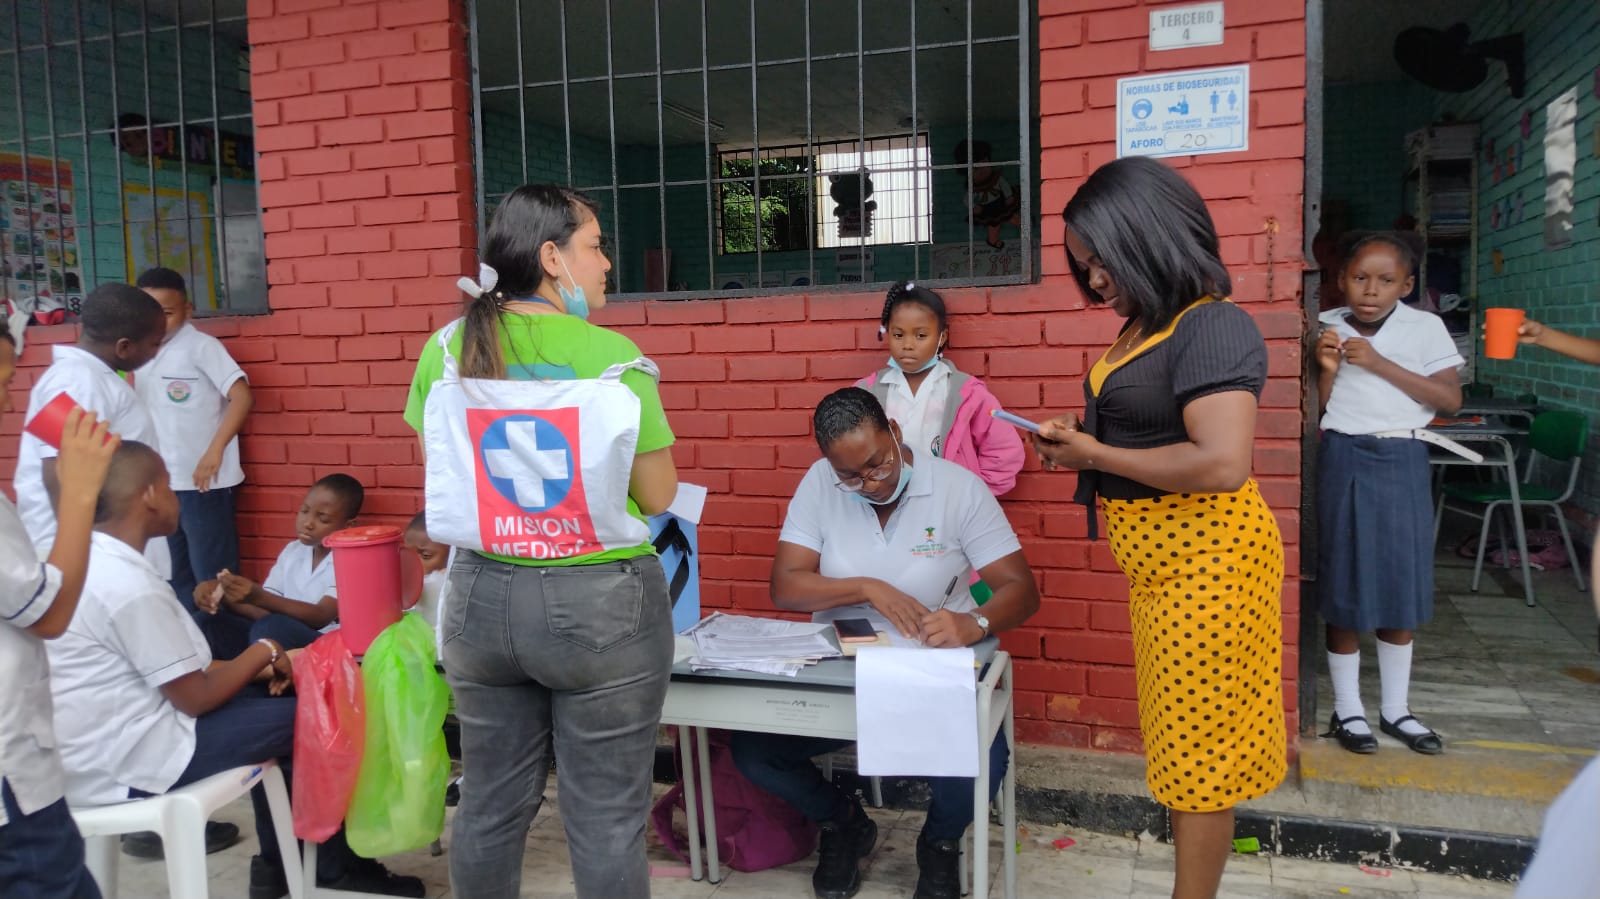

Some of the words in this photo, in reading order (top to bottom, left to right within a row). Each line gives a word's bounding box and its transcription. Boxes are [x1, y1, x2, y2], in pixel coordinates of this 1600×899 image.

[1160, 10, 1214, 28] TERCERO
[1182, 28, 1190, 40] 4
[1126, 83, 1161, 96] NORMAS
[1163, 82, 1175, 92] DE
[1177, 76, 1240, 90] BIOSEGURIDAD
[1130, 138, 1163, 149] AFORO
[1181, 133, 1207, 149] 20
[495, 515, 581, 537] MISION
